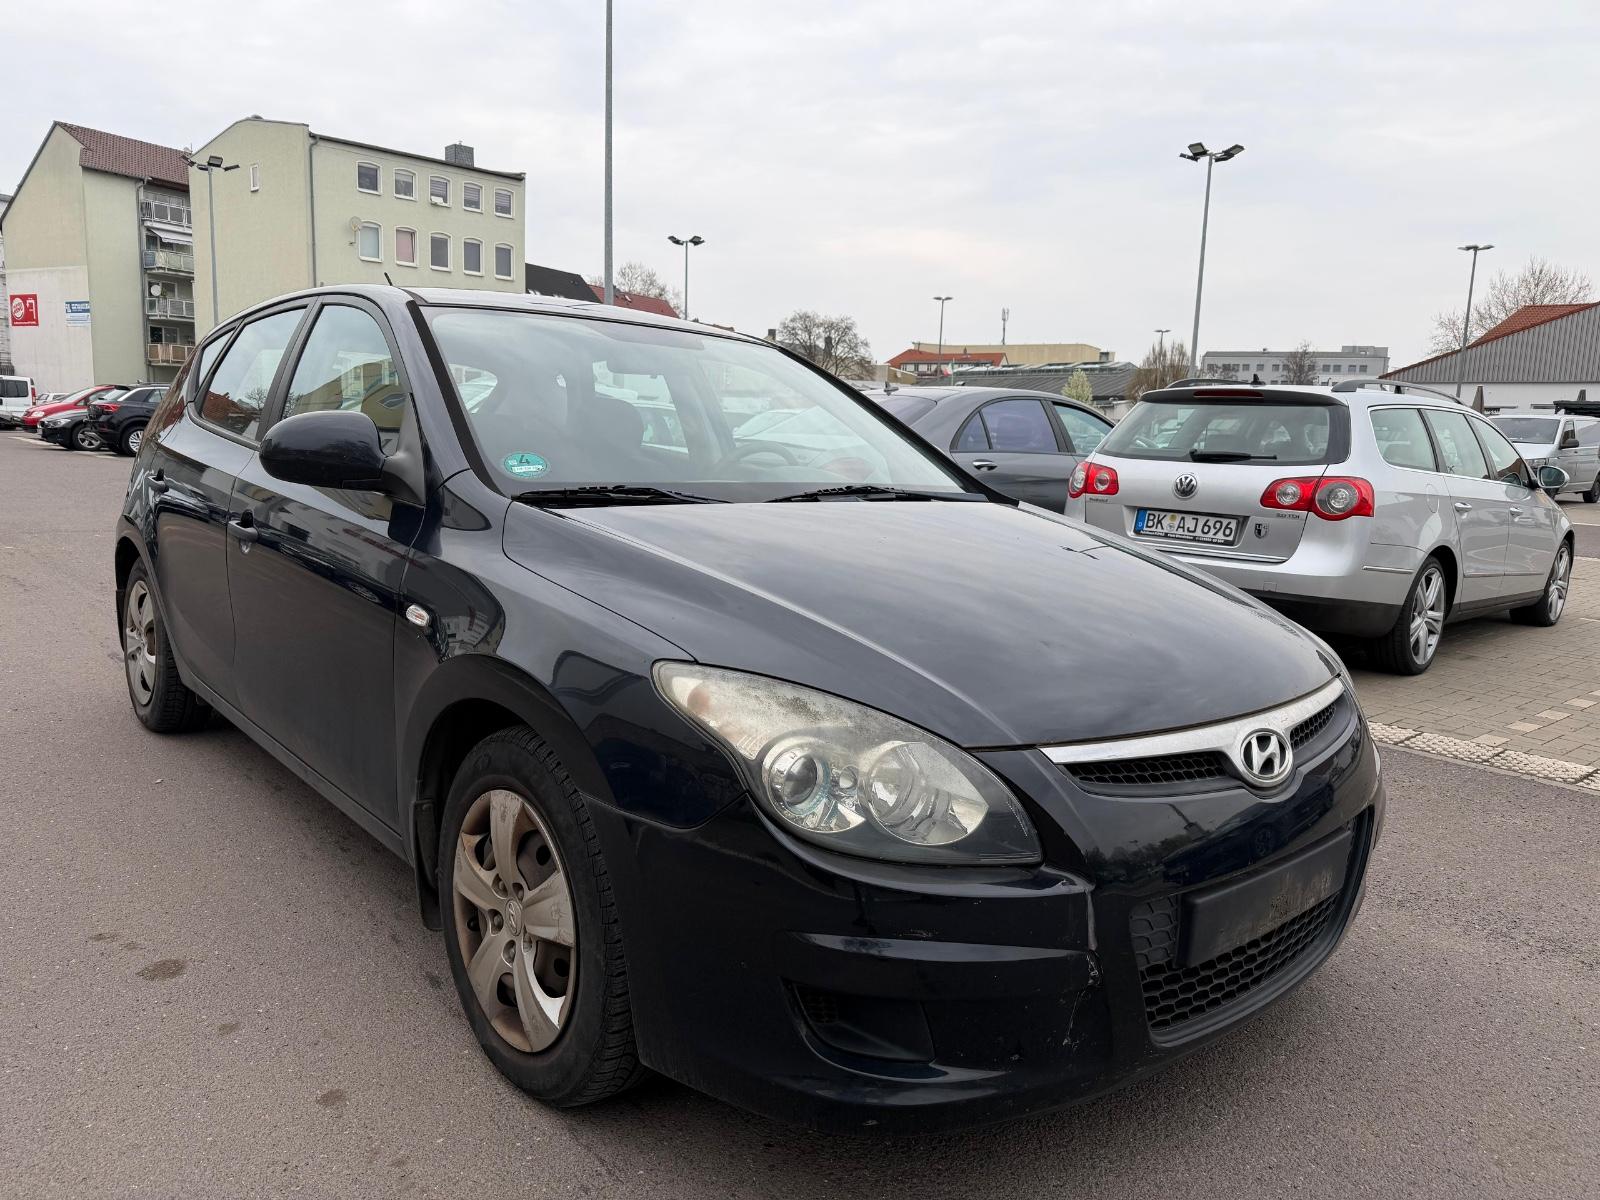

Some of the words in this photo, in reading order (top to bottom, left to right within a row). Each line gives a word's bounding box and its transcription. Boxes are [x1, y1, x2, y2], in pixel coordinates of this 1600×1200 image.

[519, 455, 530, 464] 4
[1146, 513, 1167, 530] BK
[1175, 516, 1199, 534] AJ
[1201, 519, 1233, 538] 696
